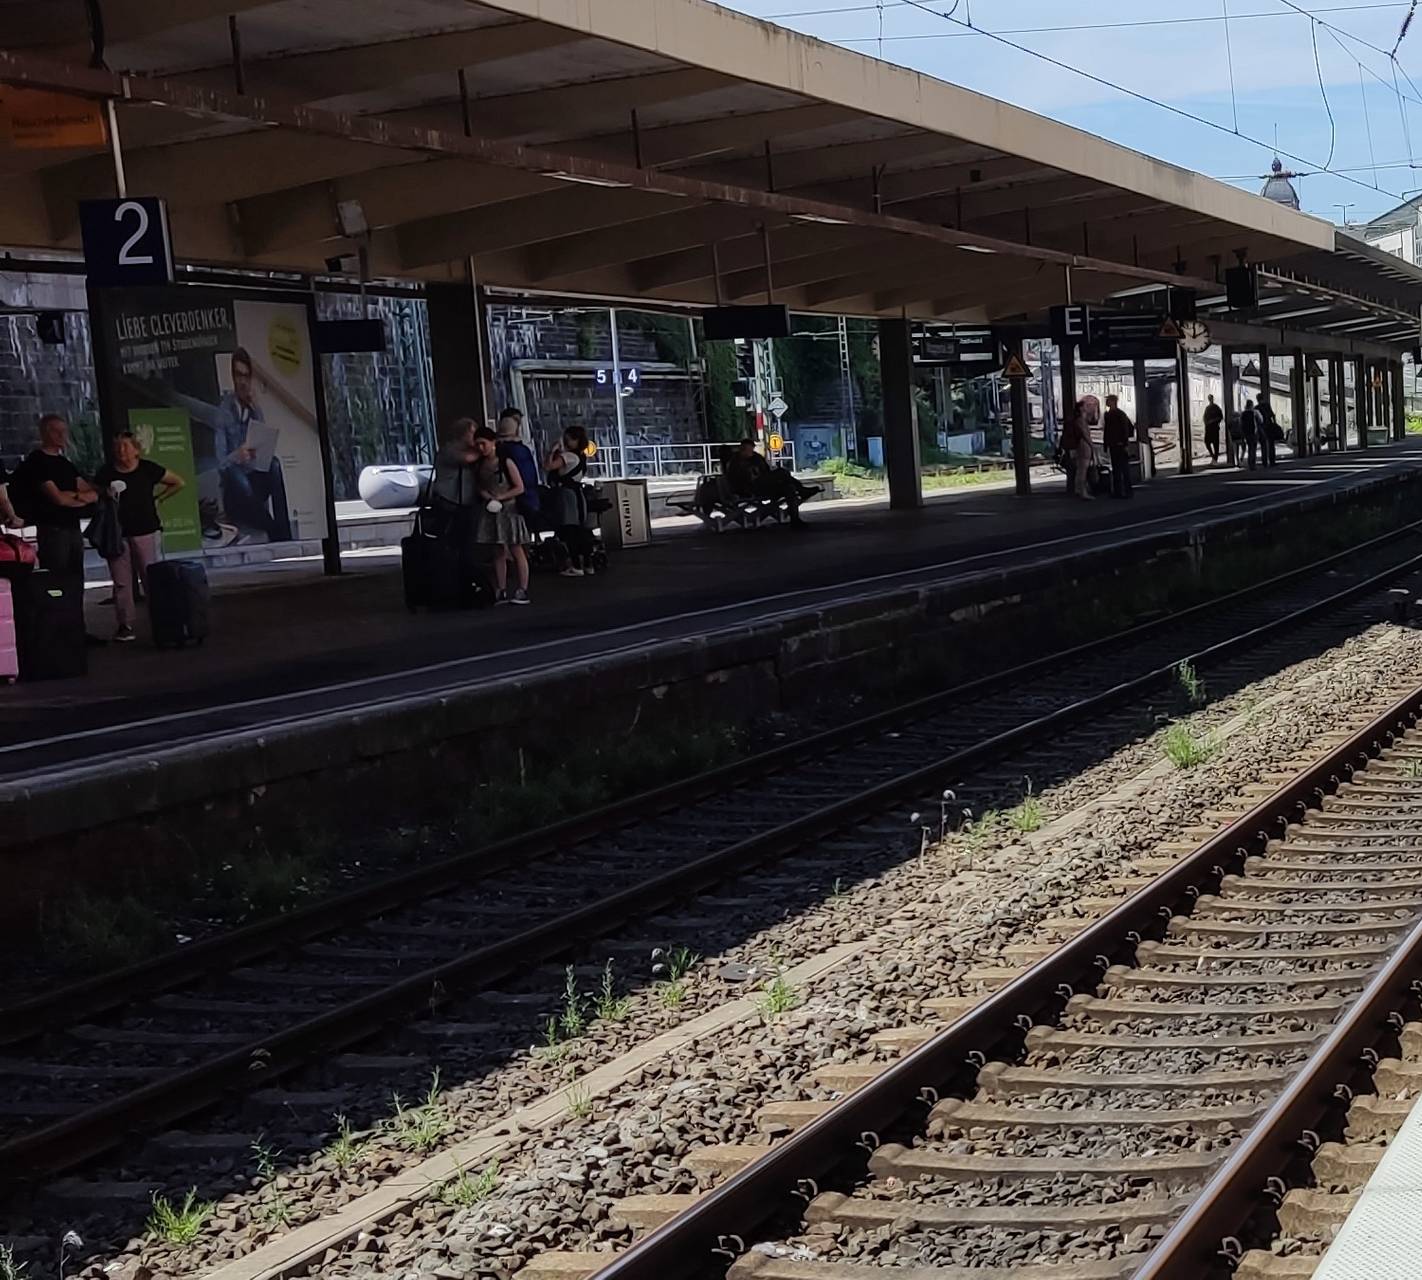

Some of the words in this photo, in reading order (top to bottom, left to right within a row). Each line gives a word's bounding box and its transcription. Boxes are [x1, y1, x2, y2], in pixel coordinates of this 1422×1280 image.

[115, 201, 153, 265] 2
[116, 312, 148, 340] LIEBE
[150, 306, 233, 337] CLEVERDENKER,
[1064, 307, 1083, 335] E
[596, 369, 606, 383] 5
[628, 368, 638, 383] 4
[623, 499, 632, 537] Abfall
